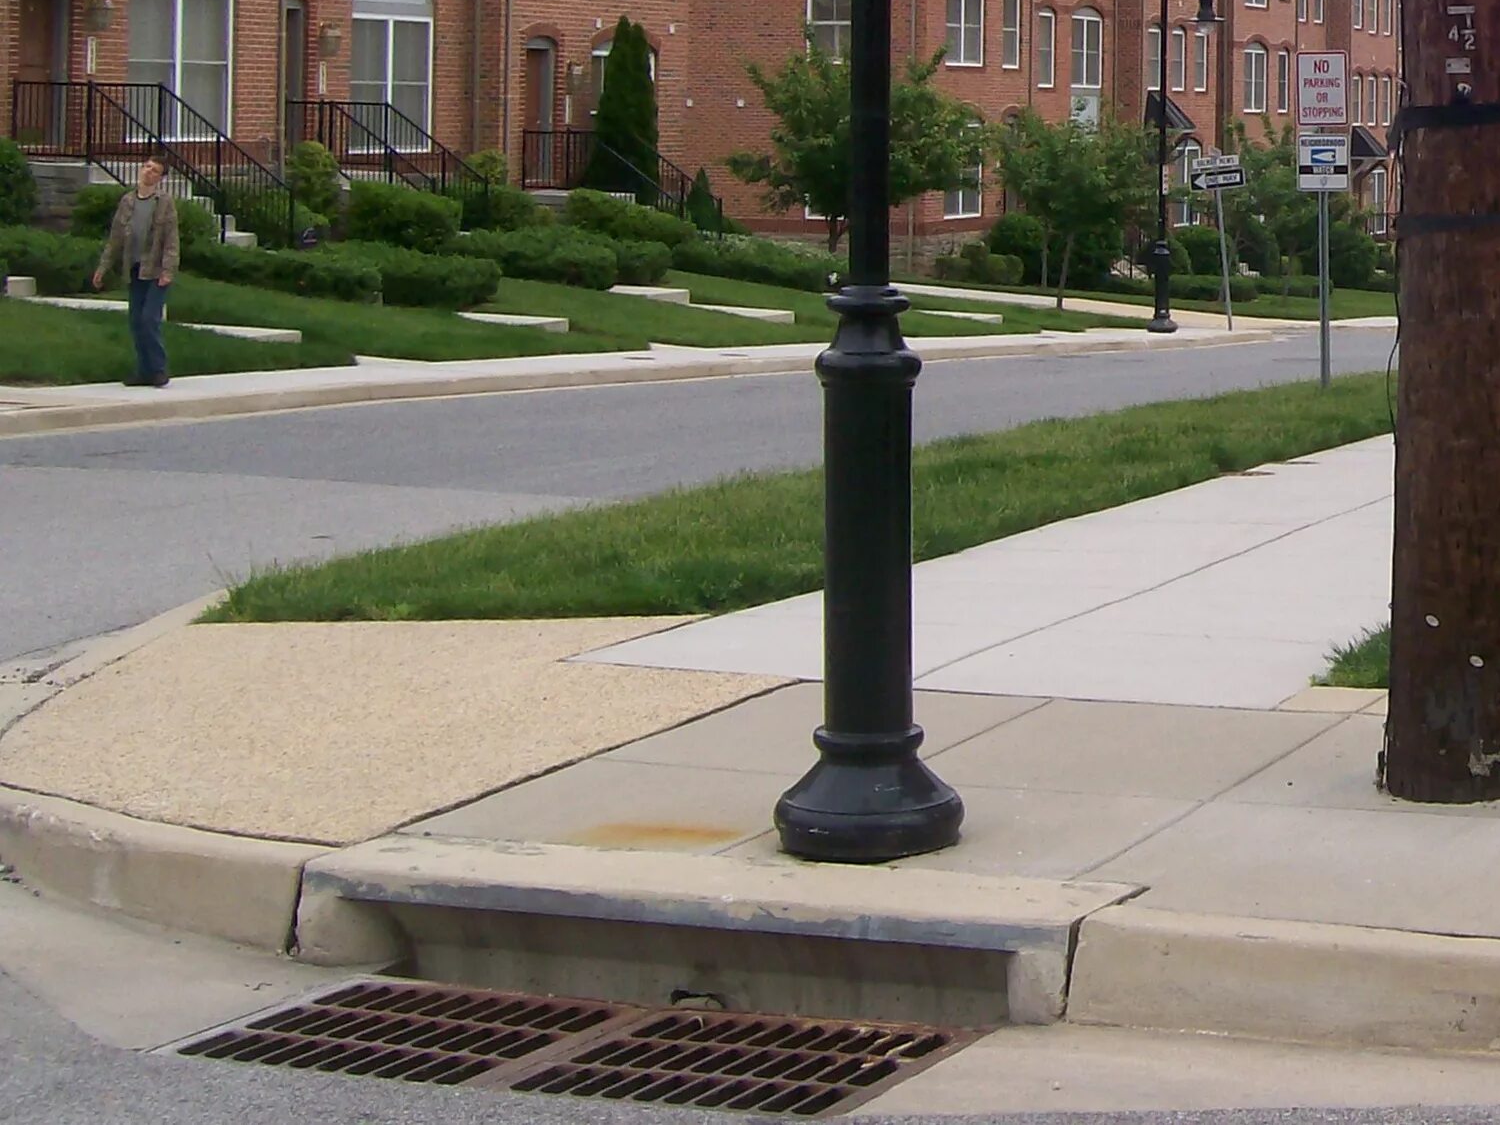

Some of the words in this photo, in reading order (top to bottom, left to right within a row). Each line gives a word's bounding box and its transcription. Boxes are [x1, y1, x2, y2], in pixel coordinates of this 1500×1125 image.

[1313, 60, 1330, 74] NO
[1303, 77, 1341, 88] PARKING
[1315, 93, 1329, 102] OR
[1302, 106, 1344, 118] STOPPING
[1301, 139, 1345, 147] NEIGHBORHOOD
[1222, 174, 1237, 182] WAY
